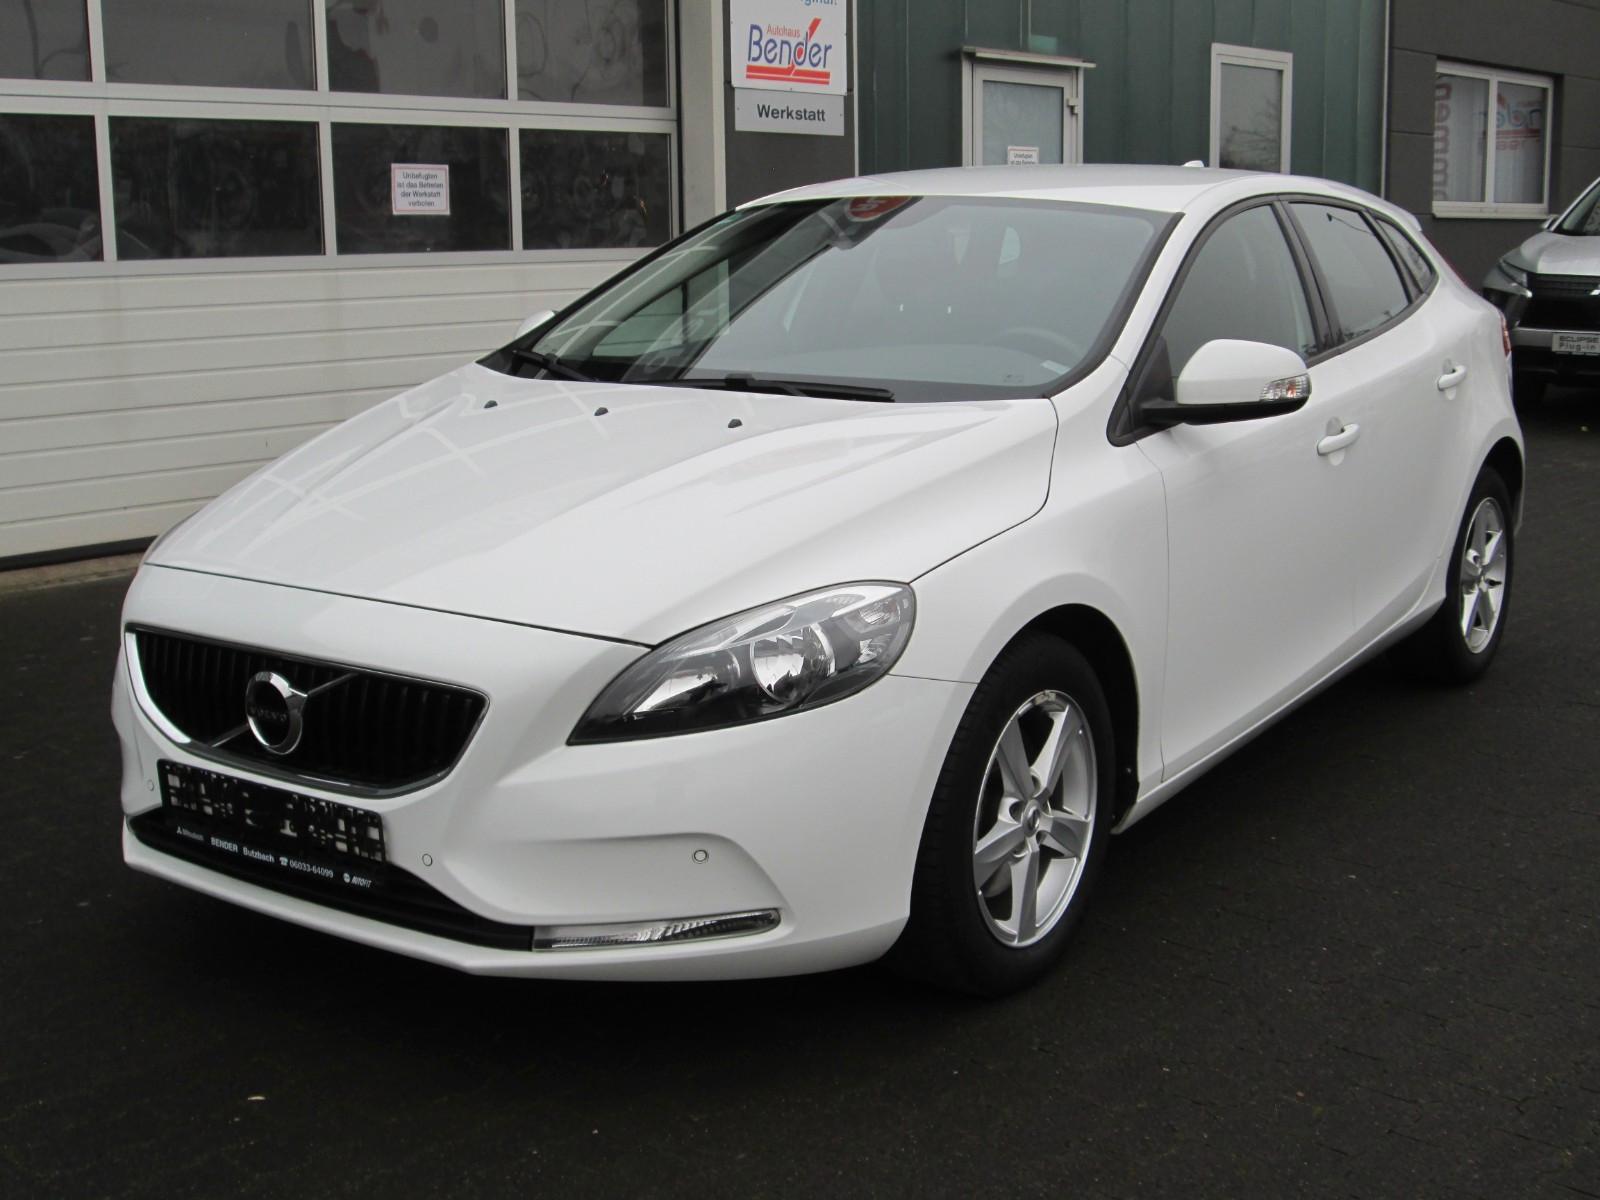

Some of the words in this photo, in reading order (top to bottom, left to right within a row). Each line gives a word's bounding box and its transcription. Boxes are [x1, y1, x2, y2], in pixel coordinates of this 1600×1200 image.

[748, 23, 832, 68] Bender
[766, 25, 801, 38] Autohaus
[757, 104, 826, 122] Werkstatt
[210, 836, 238, 853] BENDER
[243, 847, 275, 864] Butzbach
[289, 859, 334, 878] 06033-64099
